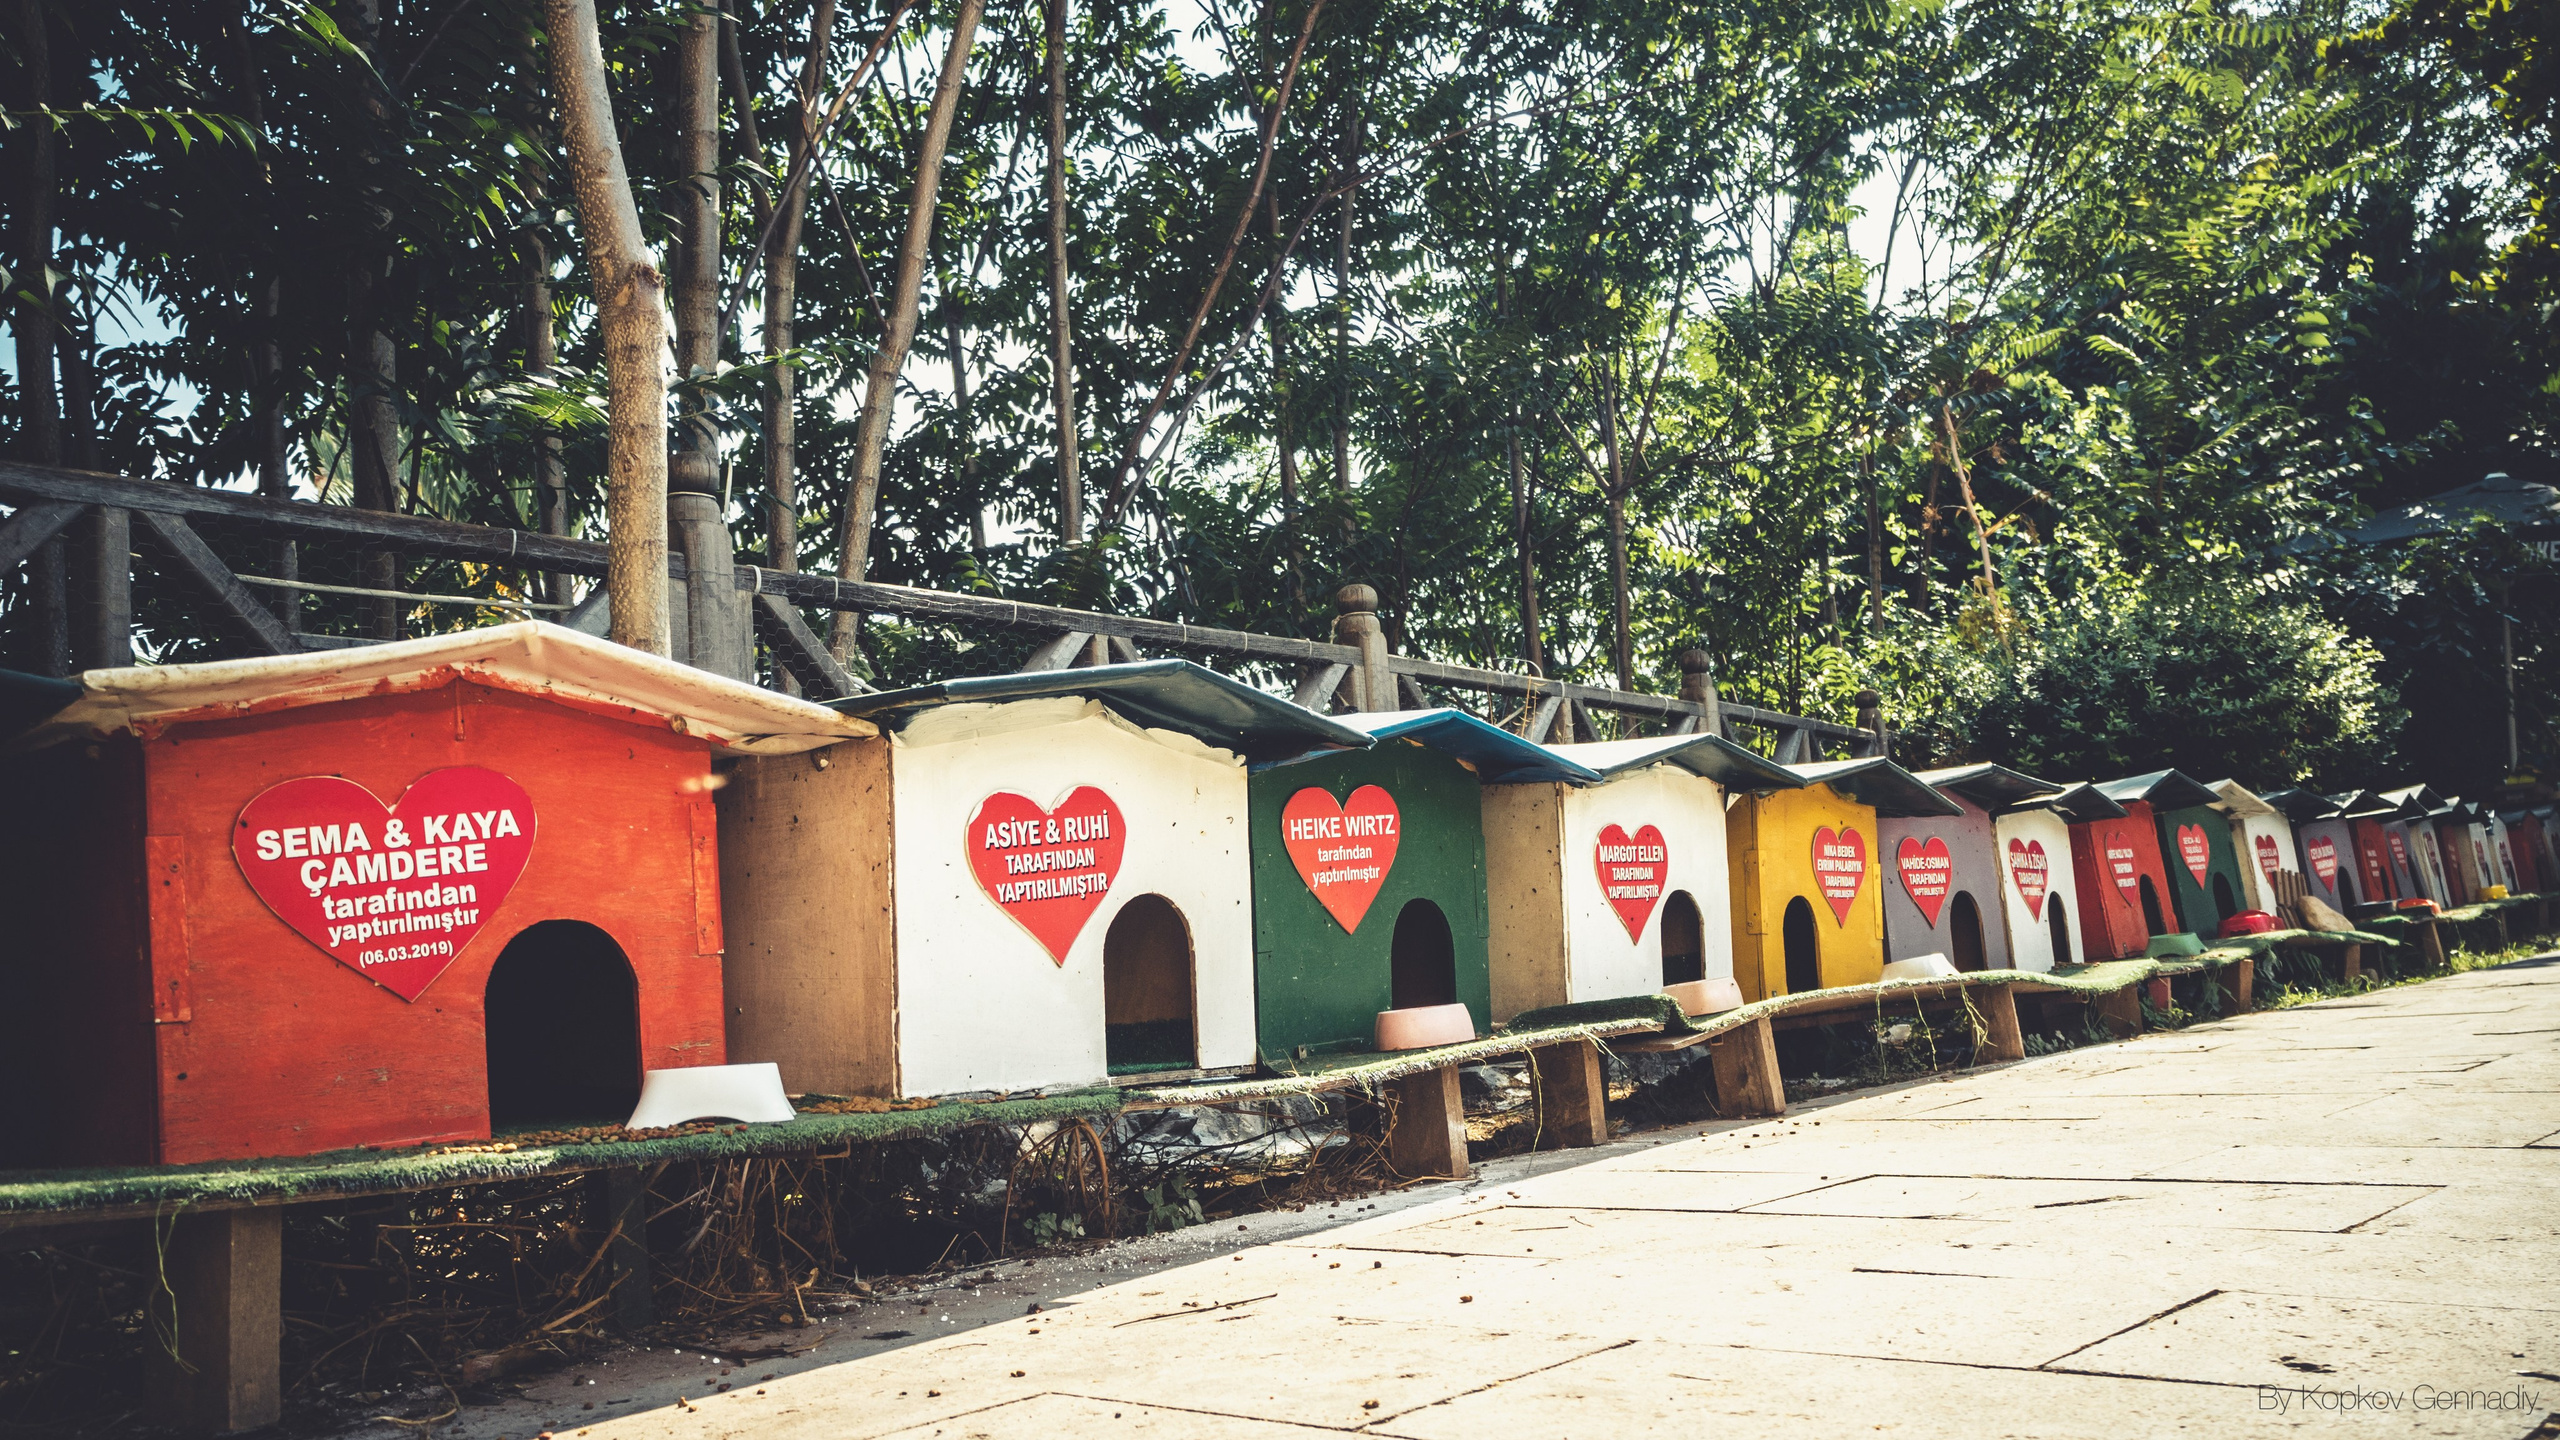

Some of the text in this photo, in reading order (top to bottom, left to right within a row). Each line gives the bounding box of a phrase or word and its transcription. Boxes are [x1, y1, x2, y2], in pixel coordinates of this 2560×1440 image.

[256, 809, 521, 861] SEMA & KAYA
[985, 809, 1110, 849] ASİYE & RUHİ
[1290, 814, 1395, 840] HEIKE WIRTZ
[1005, 847, 1095, 875] TARAFINDAN
[1317, 845, 1372, 862] tarafından
[1599, 845, 1664, 862] MARGOT ELLEN
[1901, 854, 1950, 870] VAHİDE-OSMAN
[300, 843, 489, 898] ÇAMDERE
[1312, 865, 1380, 888] yaptırılmıştır
[1612, 867, 1654, 881] TARAFINDAN
[1908, 872, 1946, 885] TARAFINDAN
[996, 872, 1109, 902] YAPTIRILMIŞTIR
[1608, 885, 1659, 901] YAPTIRILMIŞTIR
[322, 882, 477, 920] tarafından
[327, 907, 480, 948] yaptırılmıştır
[359, 940, 454, 969] (06.03.2019)
